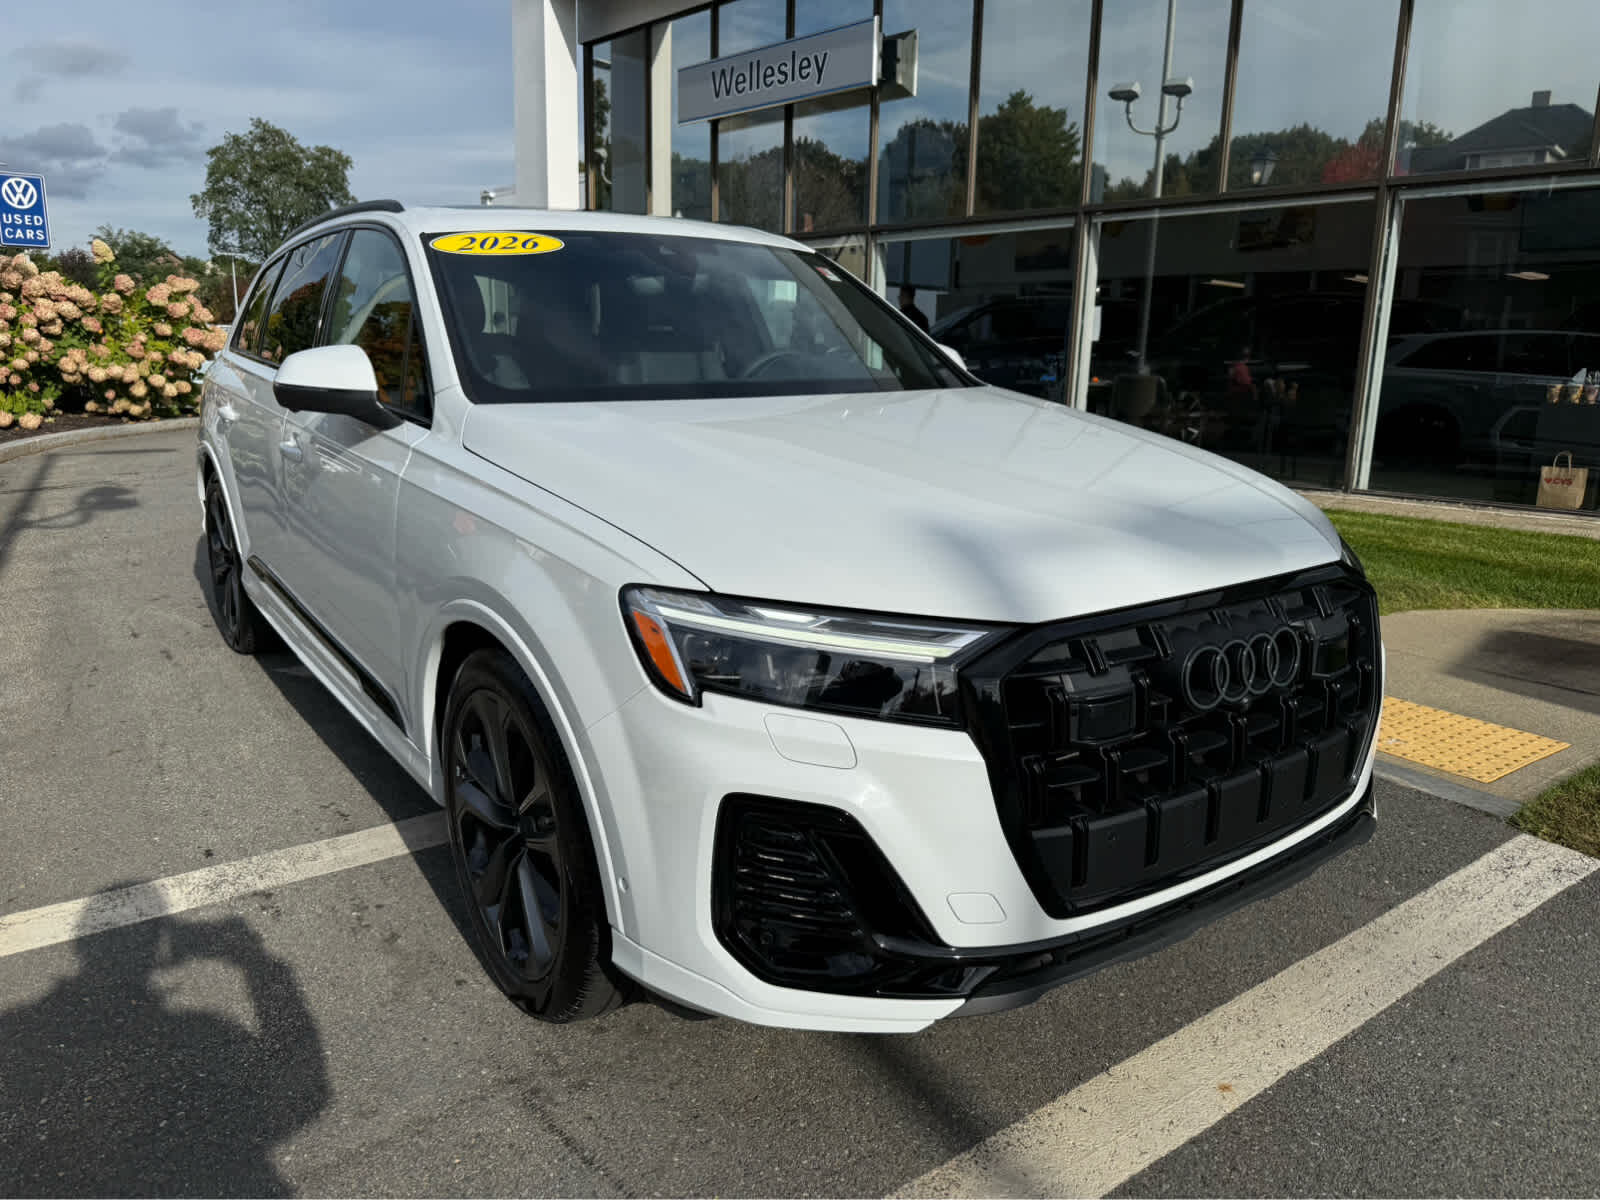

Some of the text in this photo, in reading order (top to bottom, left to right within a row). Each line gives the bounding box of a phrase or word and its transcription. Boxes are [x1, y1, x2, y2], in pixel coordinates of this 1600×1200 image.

[711, 51, 828, 99] Wellesley
[2, 213, 43, 226] USED
[4, 227, 45, 240] CARS
[456, 236, 541, 251] 2026
